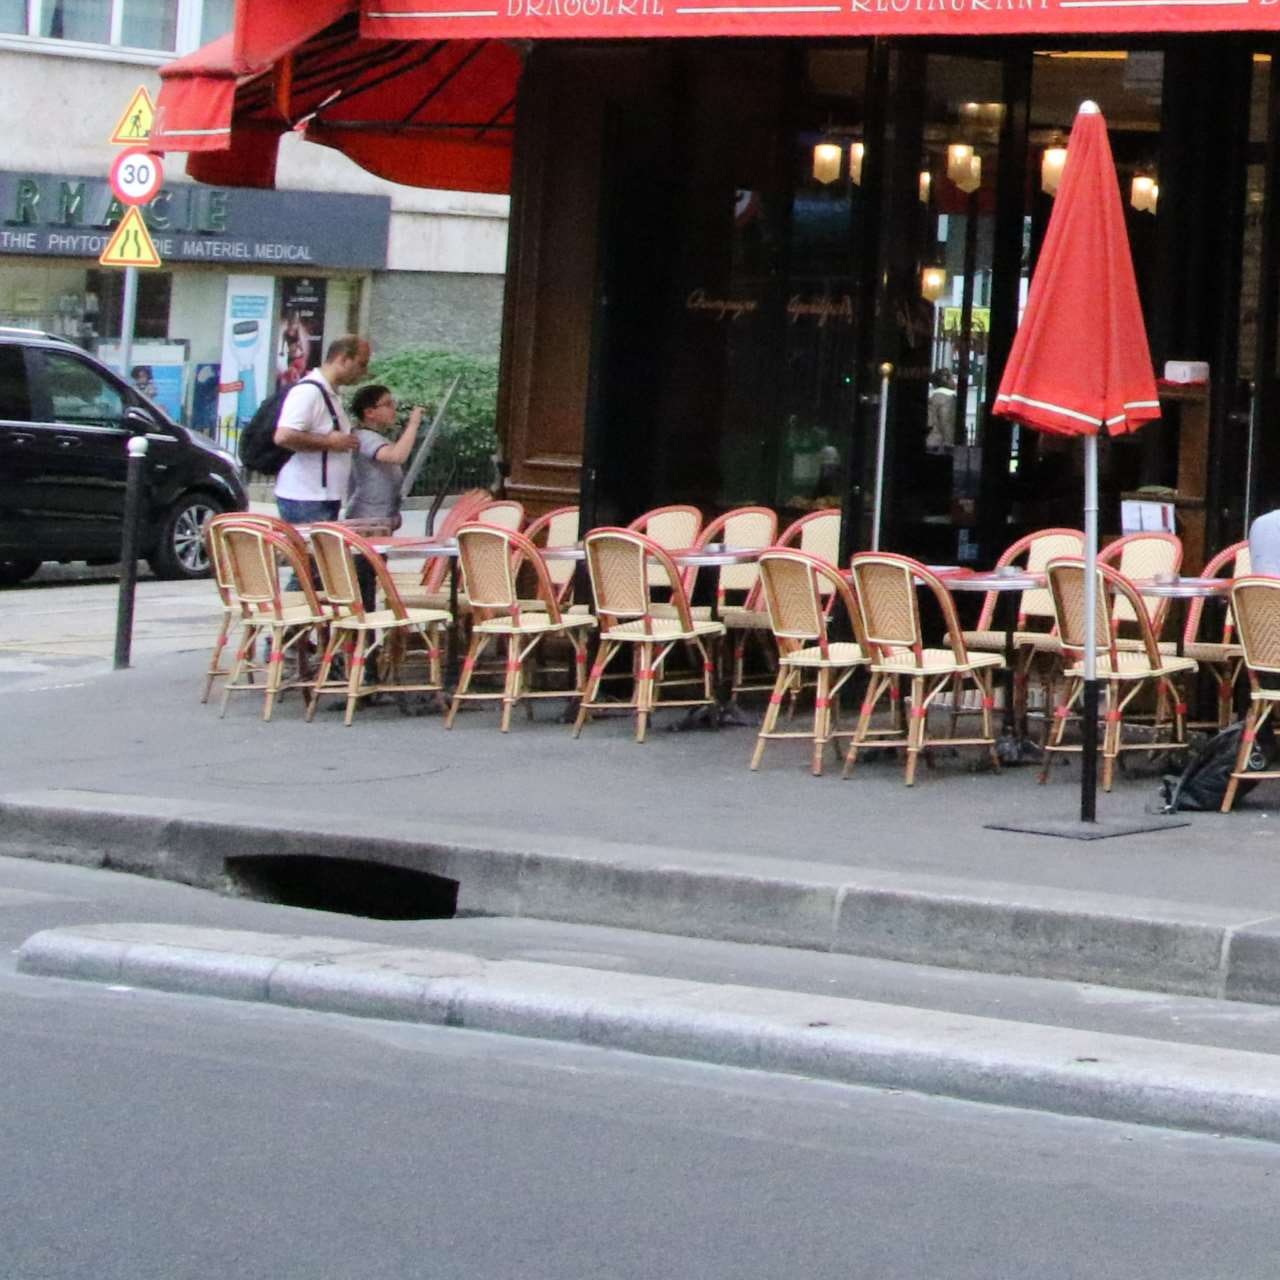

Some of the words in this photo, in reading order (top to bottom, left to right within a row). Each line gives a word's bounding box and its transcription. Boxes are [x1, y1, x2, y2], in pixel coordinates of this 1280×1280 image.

[123, 164, 150, 185] 30
[183, 239, 250, 258] MATERIEL
[255, 243, 312, 261] MEDICAL
